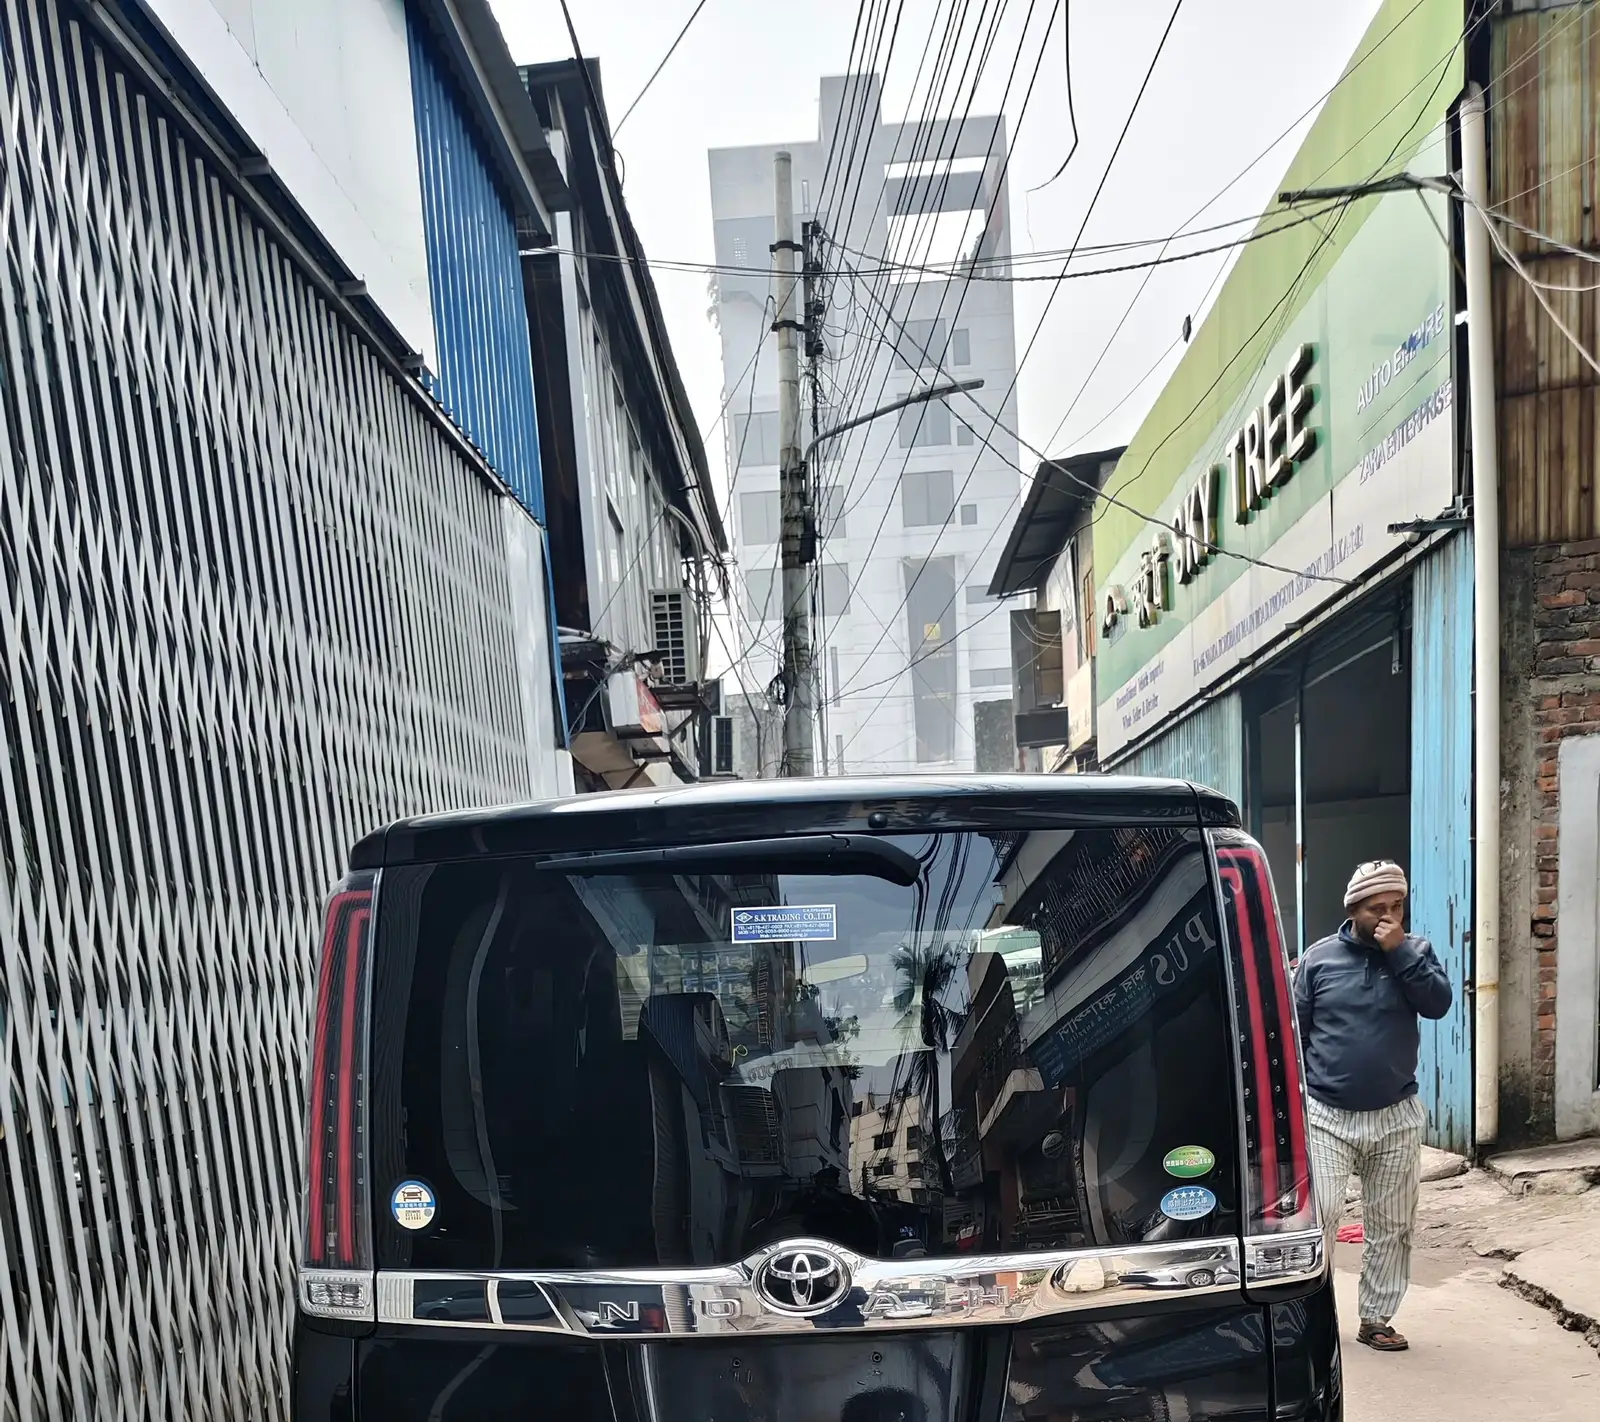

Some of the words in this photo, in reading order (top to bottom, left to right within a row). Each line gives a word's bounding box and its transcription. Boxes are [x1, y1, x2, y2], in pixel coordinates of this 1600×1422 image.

[1357, 359, 1391, 416] AUTO
[1392, 302, 1445, 377] EMPIRE
[1171, 463, 1217, 585] SKY
[1225, 343, 1316, 525] TREE
[1359, 443, 1386, 486] ZARA
[1384, 377, 1453, 461] ENTERPRISE
[767, 913, 801, 922] TRADING
